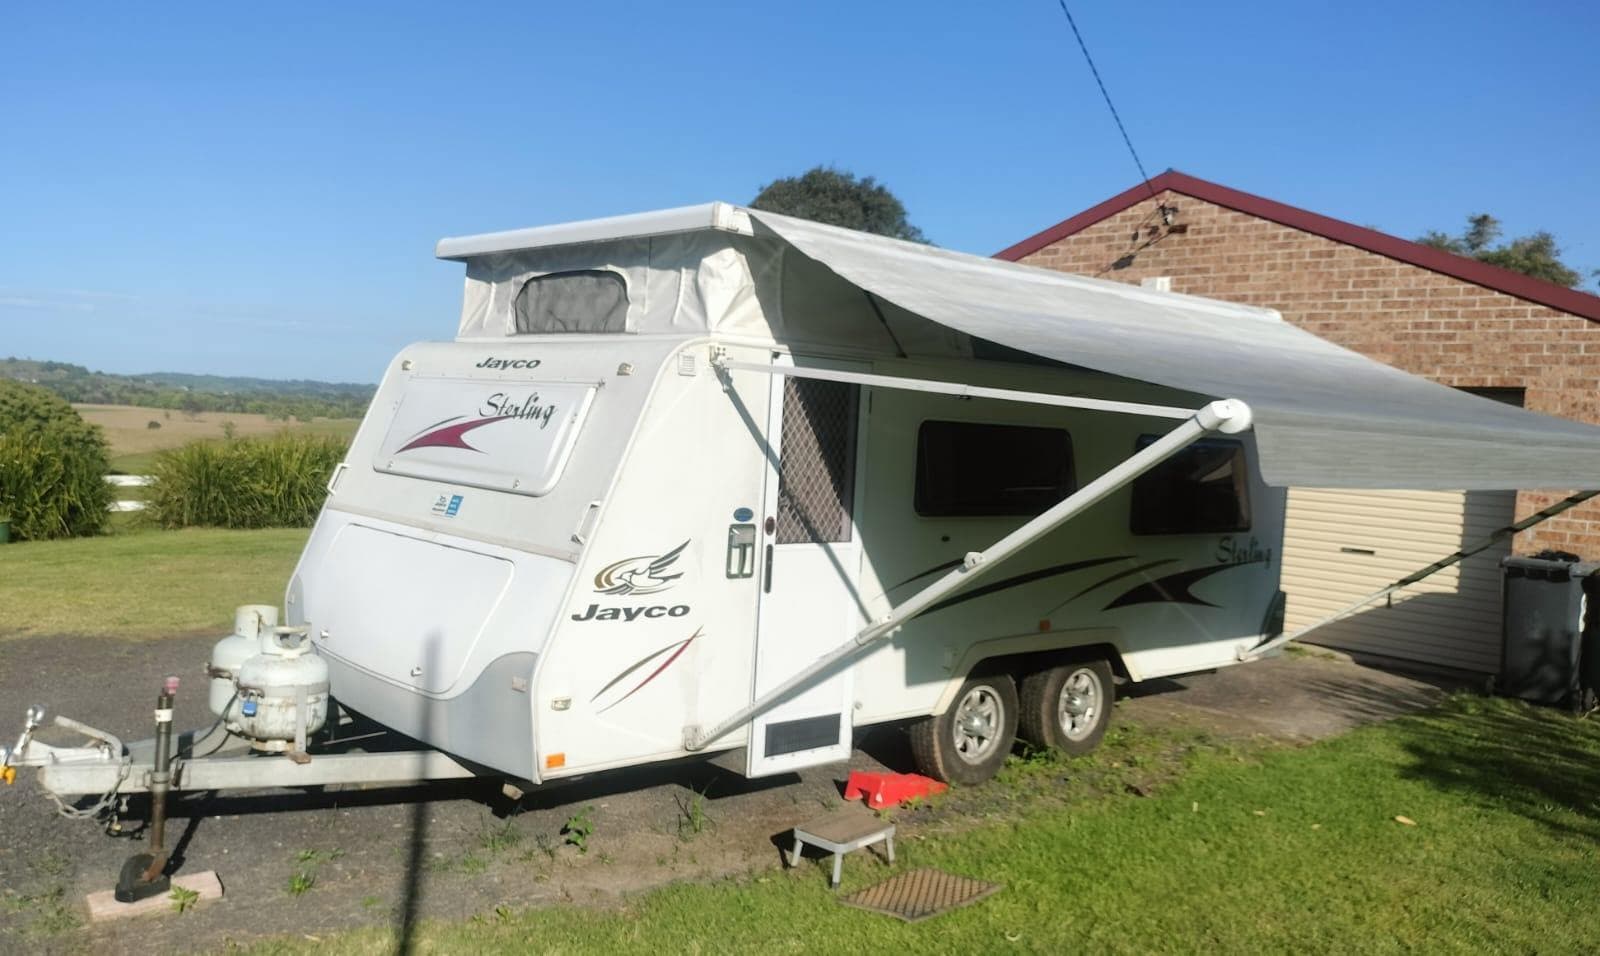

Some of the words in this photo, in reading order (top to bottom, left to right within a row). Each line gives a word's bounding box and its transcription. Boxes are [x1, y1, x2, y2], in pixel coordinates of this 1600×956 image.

[476, 357, 541, 370] Jayco
[479, 391, 556, 430] Sterling
[571, 604, 691, 621] Jayco
